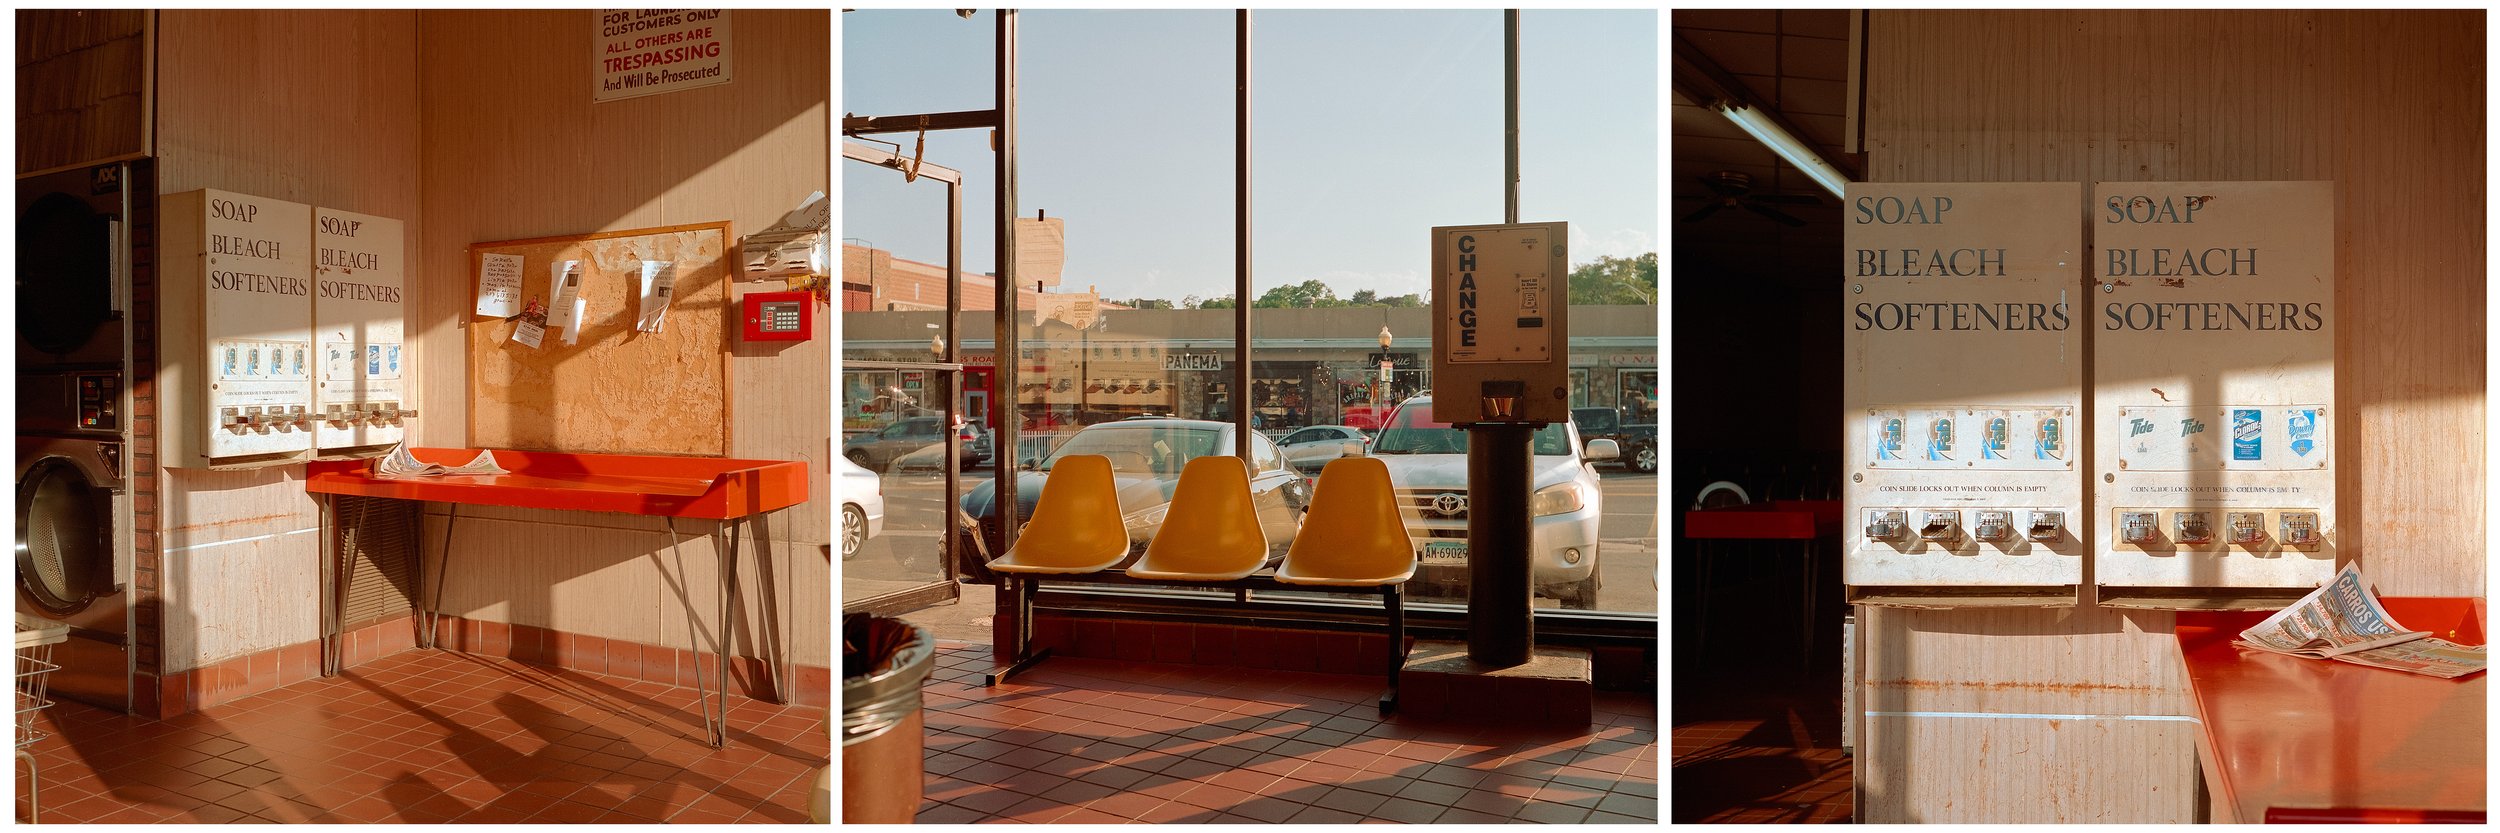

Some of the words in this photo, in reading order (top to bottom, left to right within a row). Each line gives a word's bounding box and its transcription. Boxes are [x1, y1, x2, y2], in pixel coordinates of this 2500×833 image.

[603, 12, 629, 26] FOR
[603, 14, 682, 37] CUSTOMERS
[686, 9, 720, 22] ONLY
[606, 41, 631, 55] ALL
[635, 32, 683, 49] OTHERS
[686, 27, 712, 41] ARE
[603, 42, 720, 74] TRESPASSING
[603, 77, 622, 91] And
[624, 73, 643, 88] Will
[646, 72, 660, 86] Be
[661, 62, 720, 84] Prosecuted
[212, 199, 257, 223] SOAP
[1856, 196, 1953, 225] SOAP
[2106, 195, 2204, 224] SOAP
[320, 216, 359, 238] SOAP
[212, 234, 280, 260] BLEACH
[321, 248, 378, 270] BLEACH
[1856, 248, 2007, 277] BLEACH
[2106, 248, 2258, 277] BLEACH
[211, 270, 307, 297] SOFTENERS
[320, 281, 401, 304] SOFTENERS
[1458, 235, 1476, 347] CHANGE
[1855, 302, 2070, 331] SOFTENERS
[2105, 302, 2323, 331] SOFTENERS
[1887, 418, 1902, 450] Fab
[1936, 418, 1952, 451] Fab
[1990, 418, 2006, 450] Fab
[2043, 418, 2059, 450] Fab
[2130, 418, 2155, 438] Tide
[2180, 418, 2205, 438] Tide
[2339, 576, 2373, 624] CARROS
[2368, 619, 2396, 634] US
